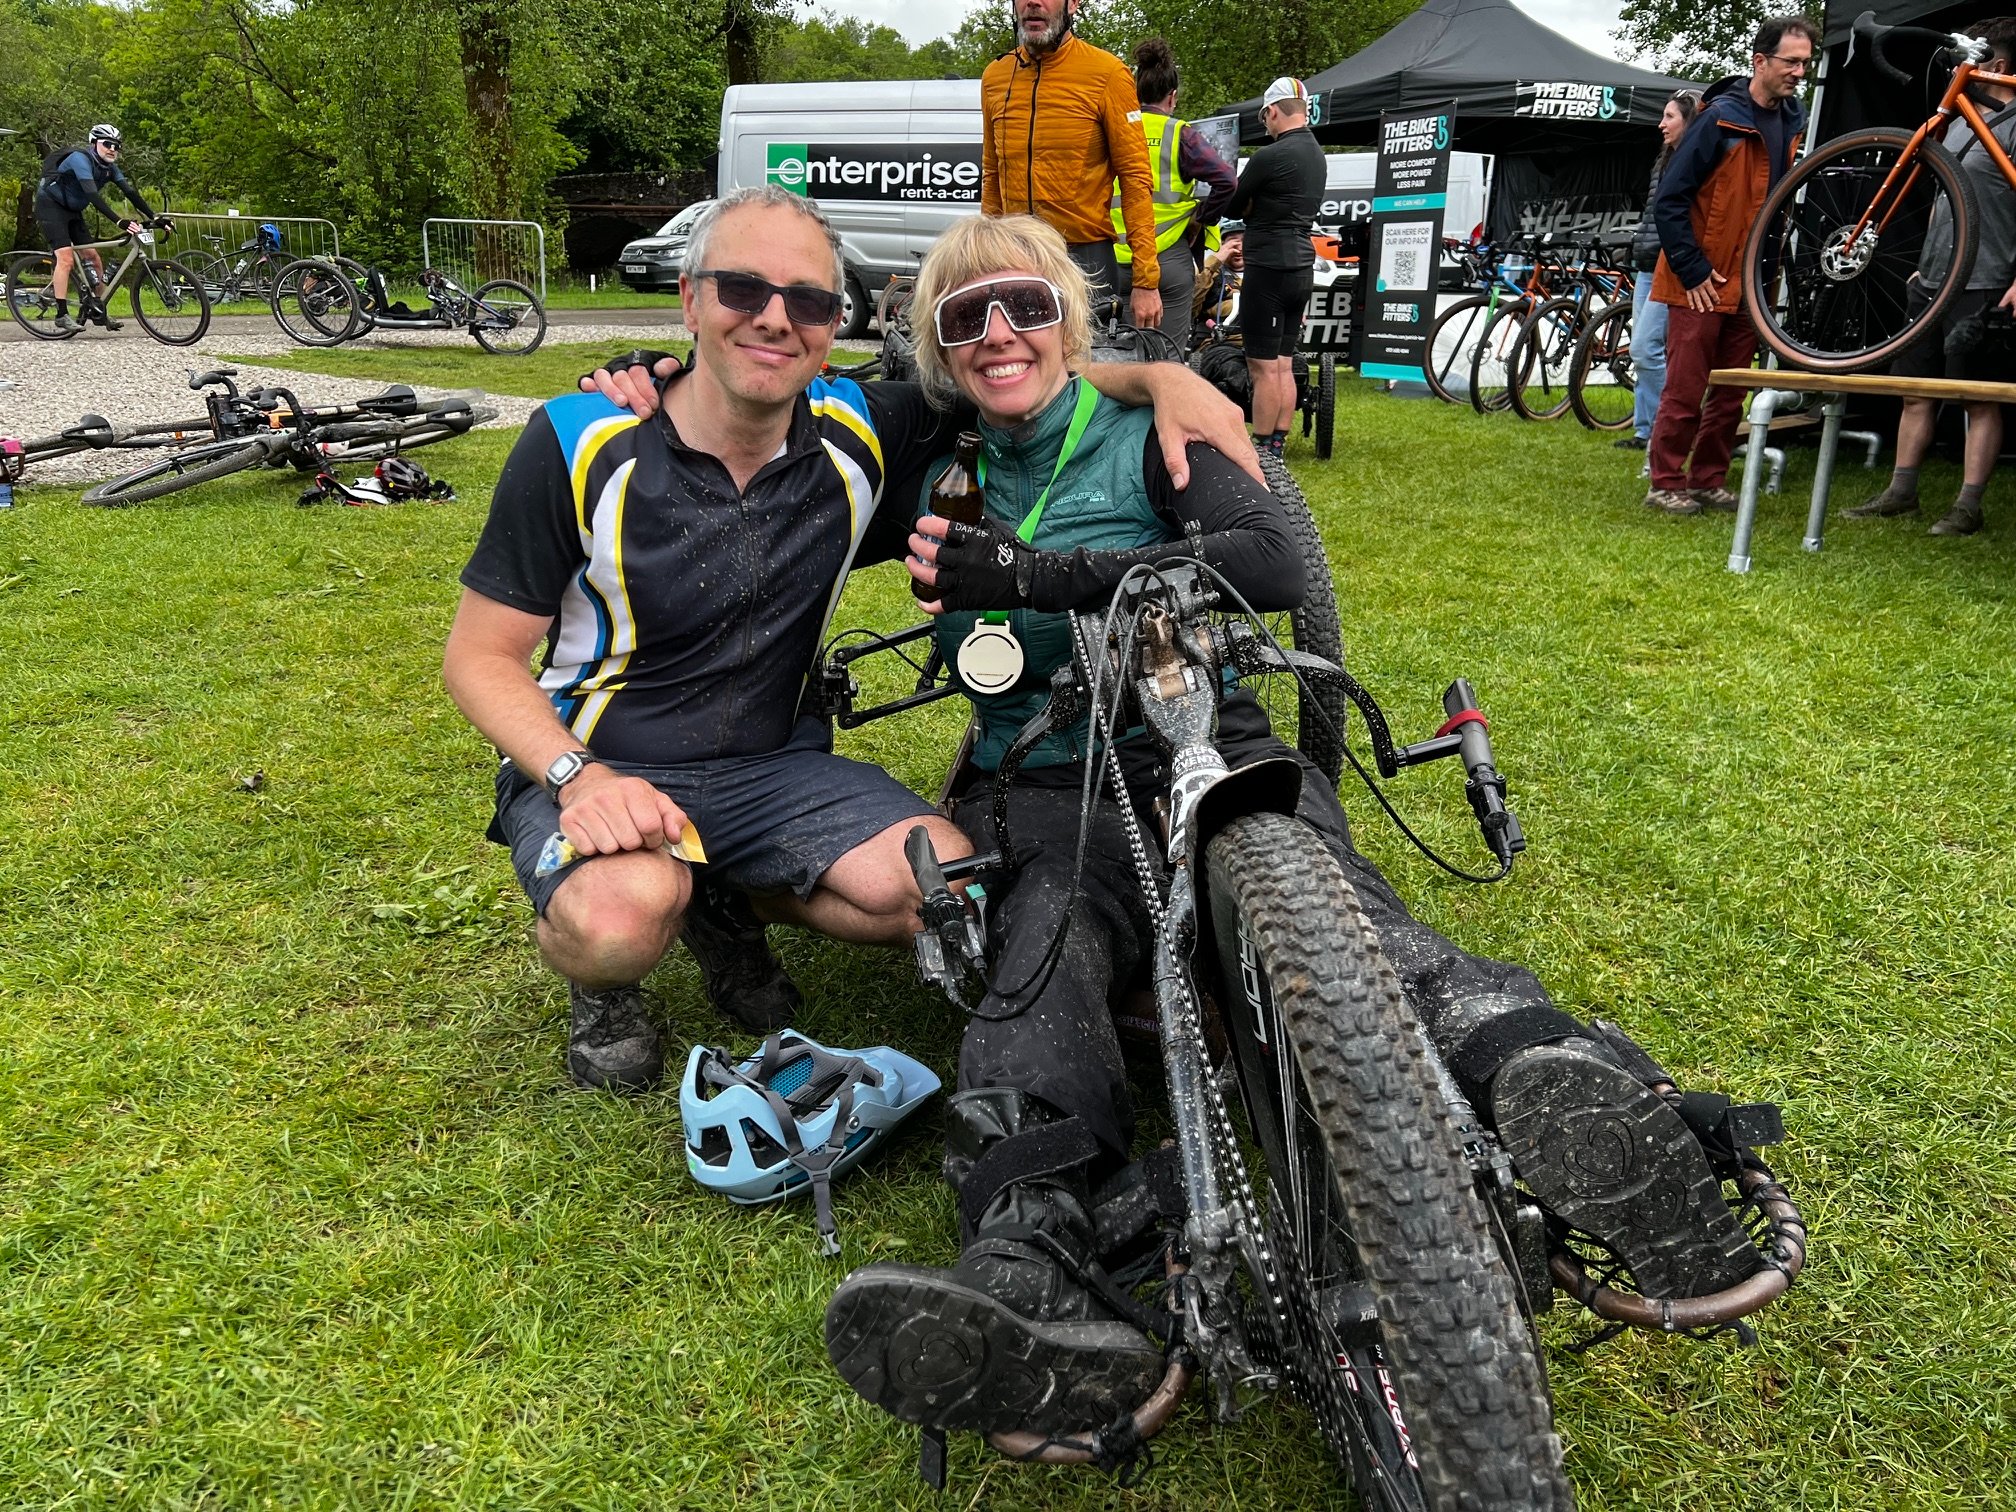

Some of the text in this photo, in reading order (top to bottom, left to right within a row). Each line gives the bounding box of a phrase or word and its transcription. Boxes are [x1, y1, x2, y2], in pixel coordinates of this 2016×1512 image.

[1534, 82, 1603, 101] THE BIKE
[1531, 98, 1599, 118] FITTERS
[1384, 116, 1438, 138] THE BIKE
[1383, 134, 1434, 155] FITTERS
[1390, 158, 1437, 169] MORE COMFORT
[778, 152, 980, 193] enterprise
[1392, 168, 1432, 179] MORE POWER
[1396, 179, 1426, 189] LESS PAIN
[900, 186, 979, 200] rent-a-car
[1385, 227, 1430, 237] SCAN HERE FOR
[1398, 237, 1411, 245] INFO
[1412, 236, 1429, 244] PACK
[1383, 303, 1413, 313] THE BIKE
[1382, 312, 1411, 322] FITTERS
[1051, 490, 1105, 507] NDURA
